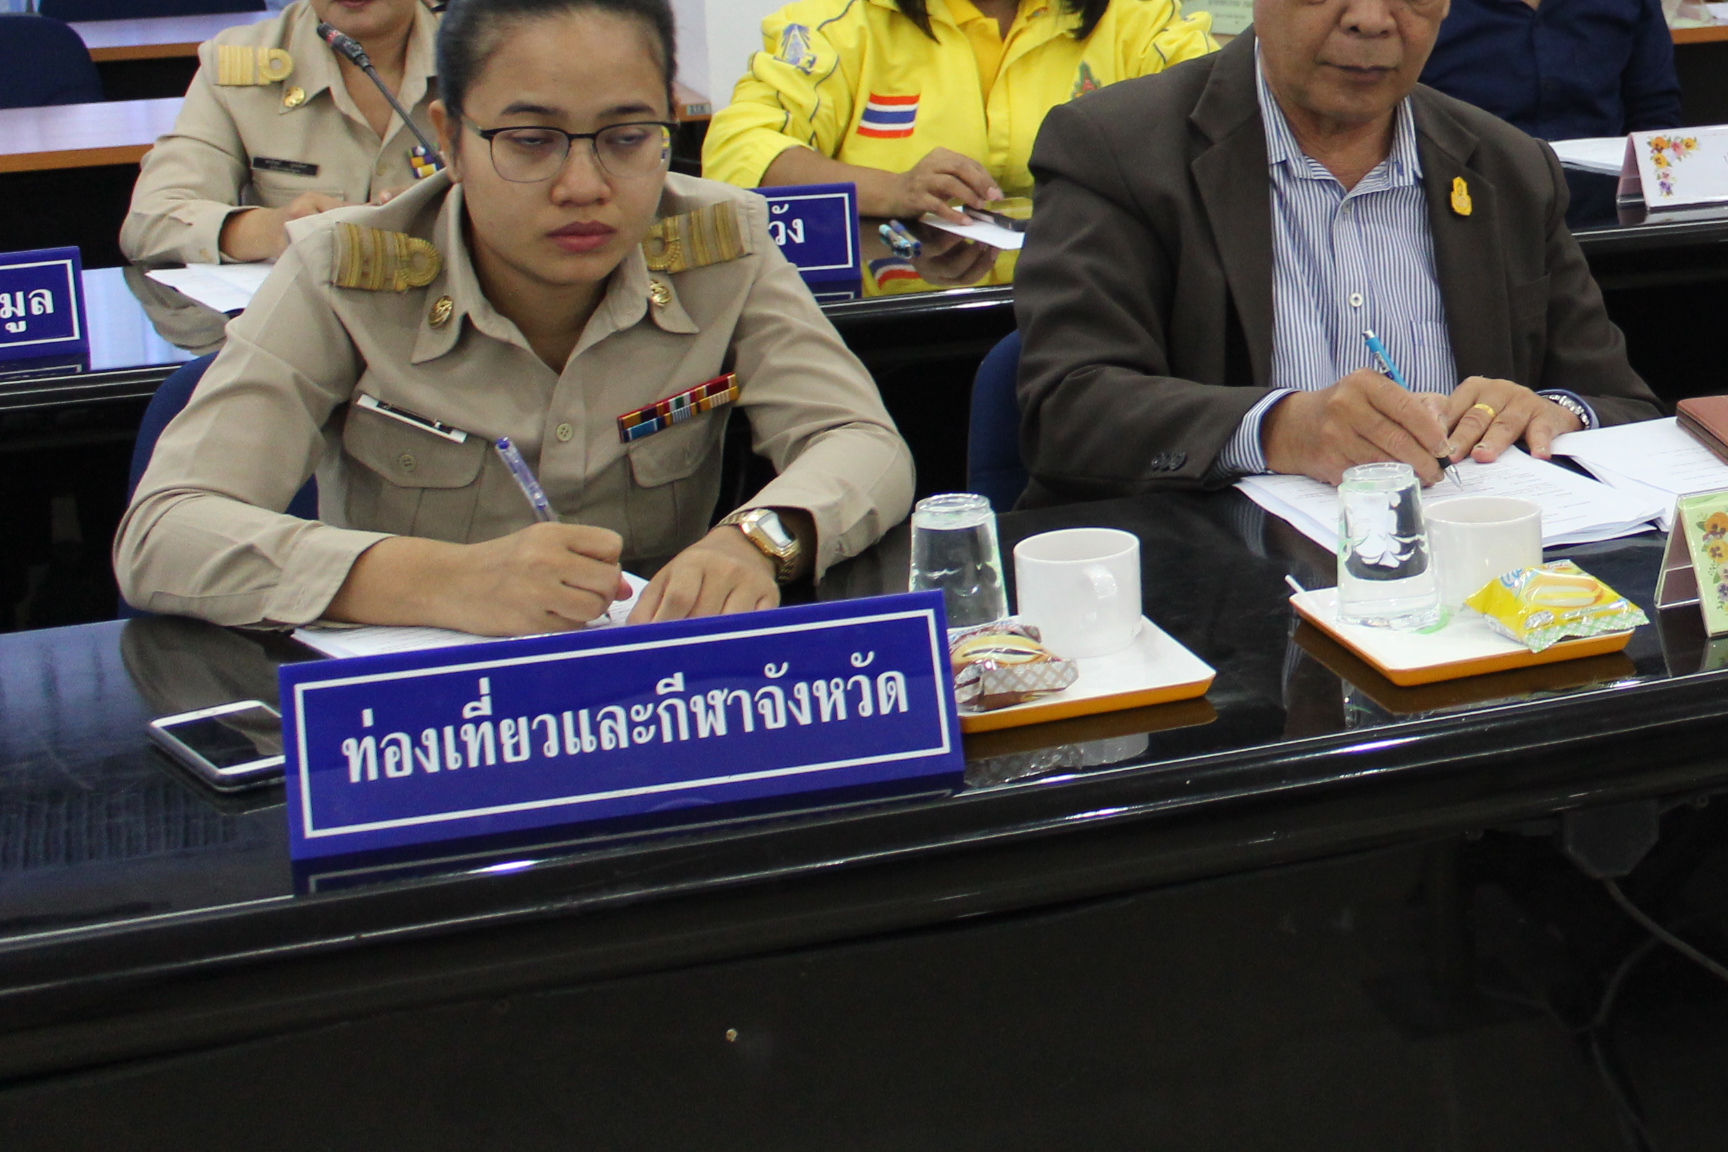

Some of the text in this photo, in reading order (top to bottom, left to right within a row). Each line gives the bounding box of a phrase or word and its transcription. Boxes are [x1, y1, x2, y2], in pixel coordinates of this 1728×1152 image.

[341, 651, 910, 784] ท่องเที่ยวและกีฬาจังหวัด
